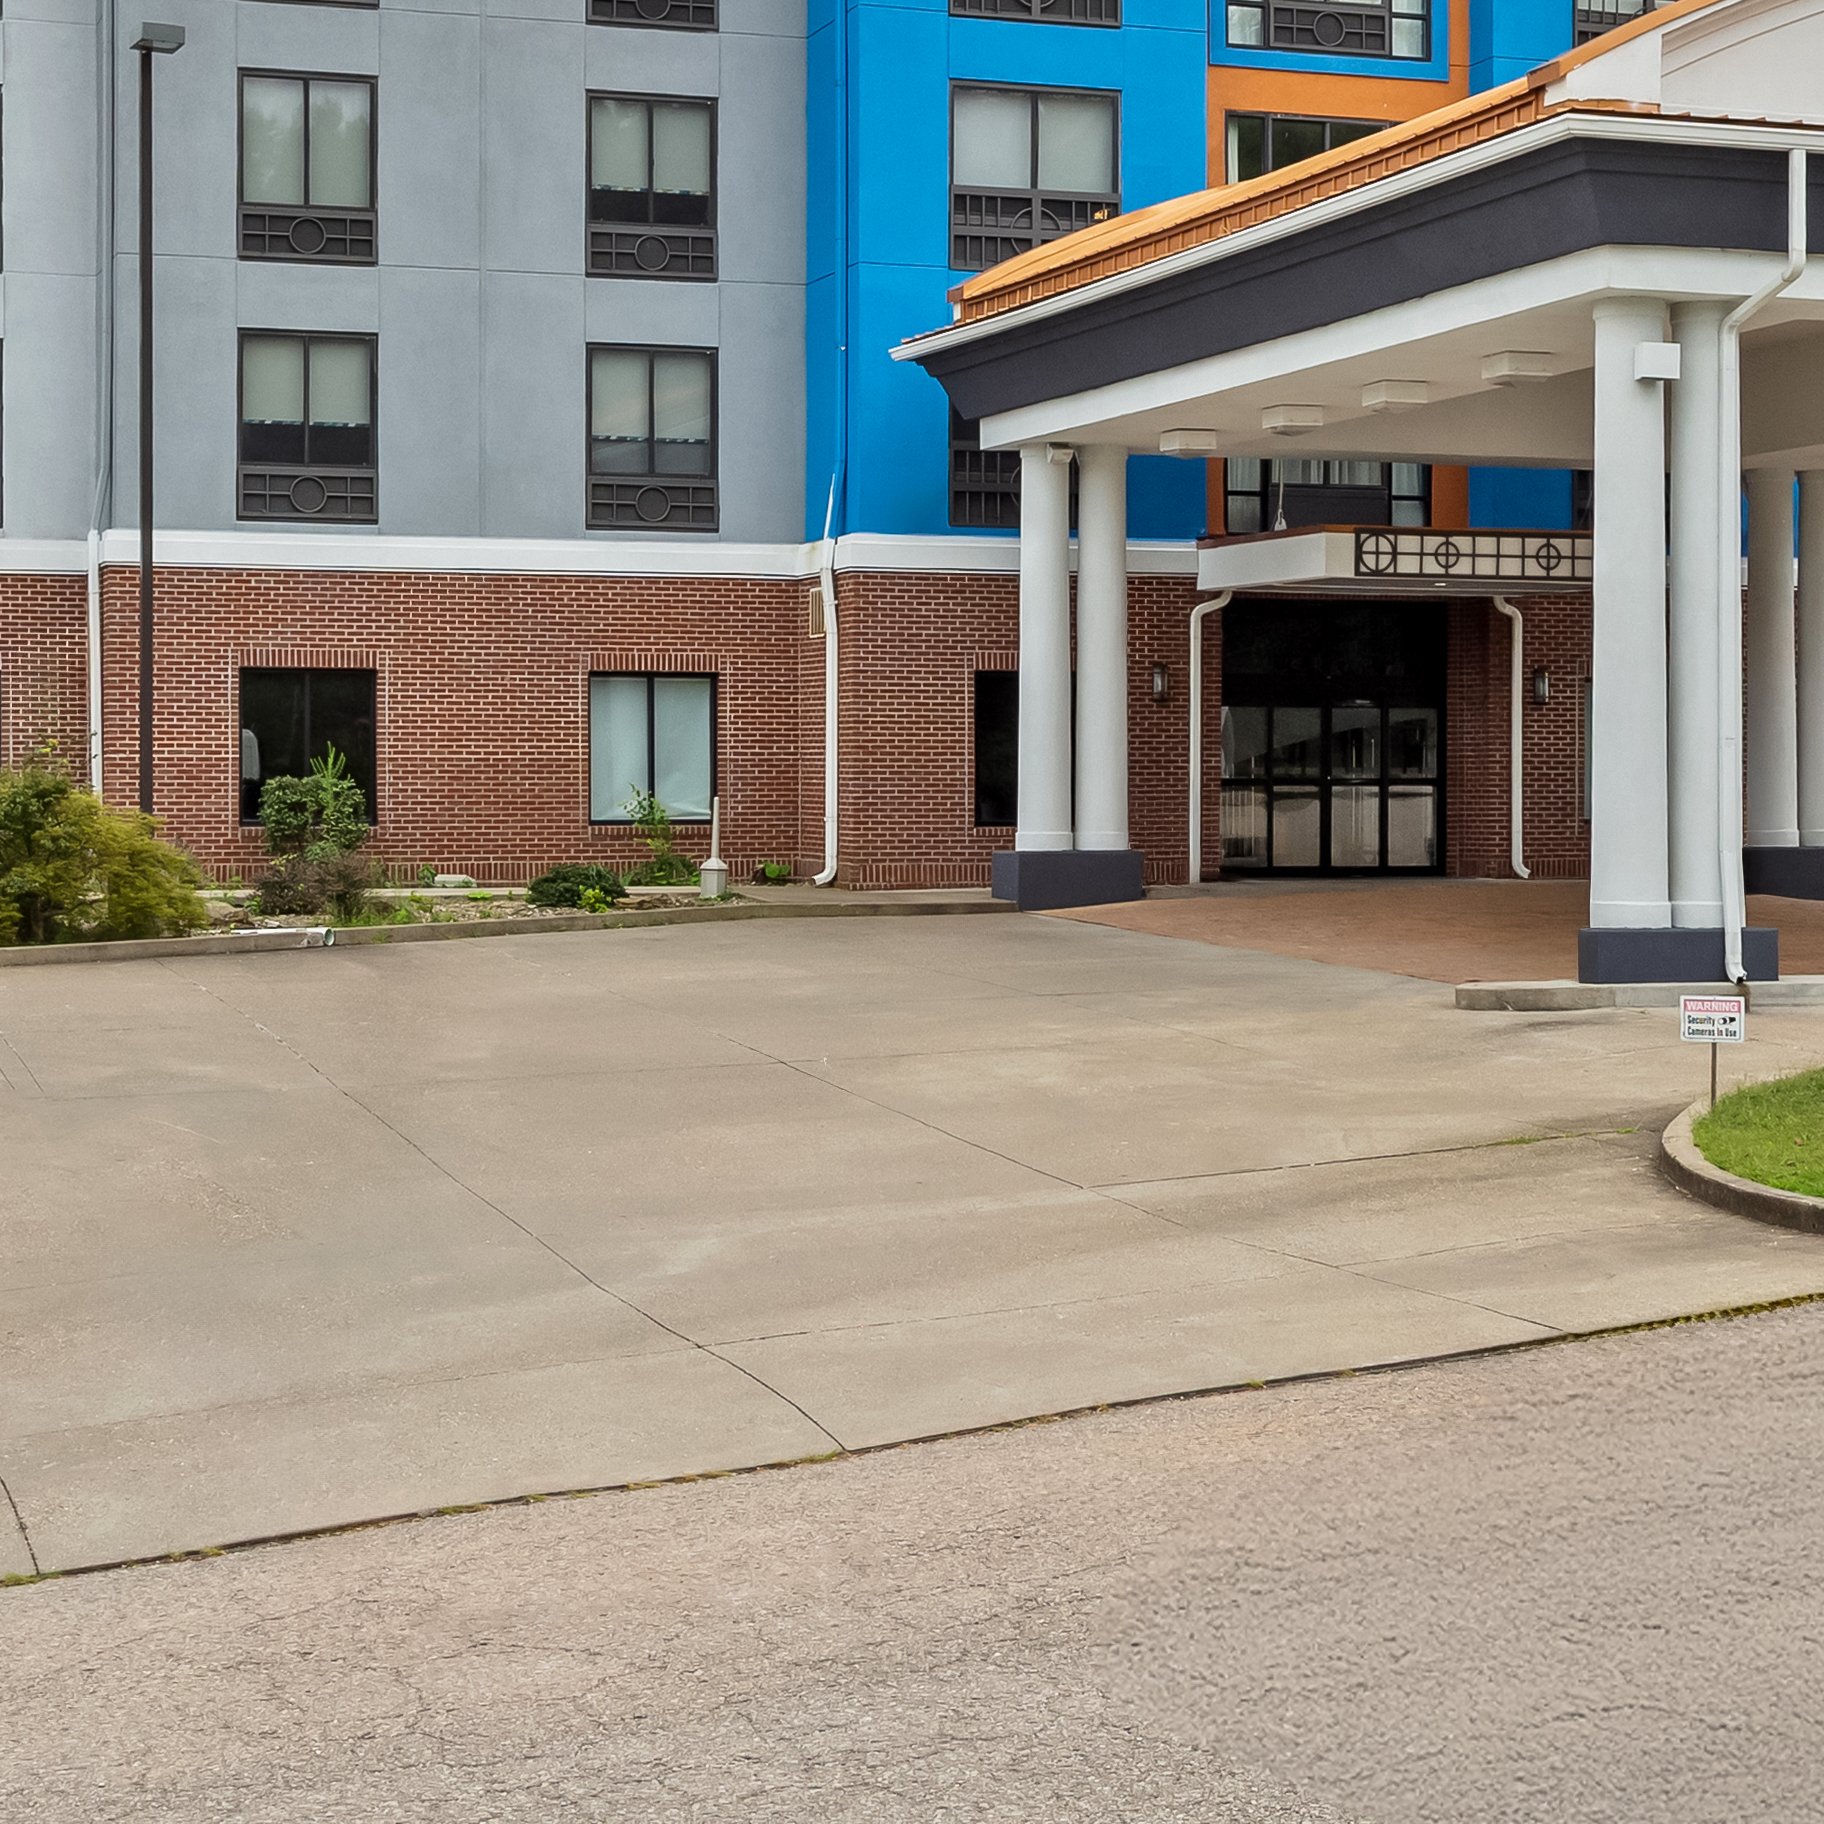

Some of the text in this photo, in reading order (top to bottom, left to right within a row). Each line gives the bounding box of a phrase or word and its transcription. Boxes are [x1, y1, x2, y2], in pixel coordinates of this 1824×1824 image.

[1686, 1001, 1738, 1011] WARNING
[1687, 1015, 1715, 1027] Security
[1687, 1026, 1715, 1036] Cameras
[1725, 1028, 1737, 1037] Use
